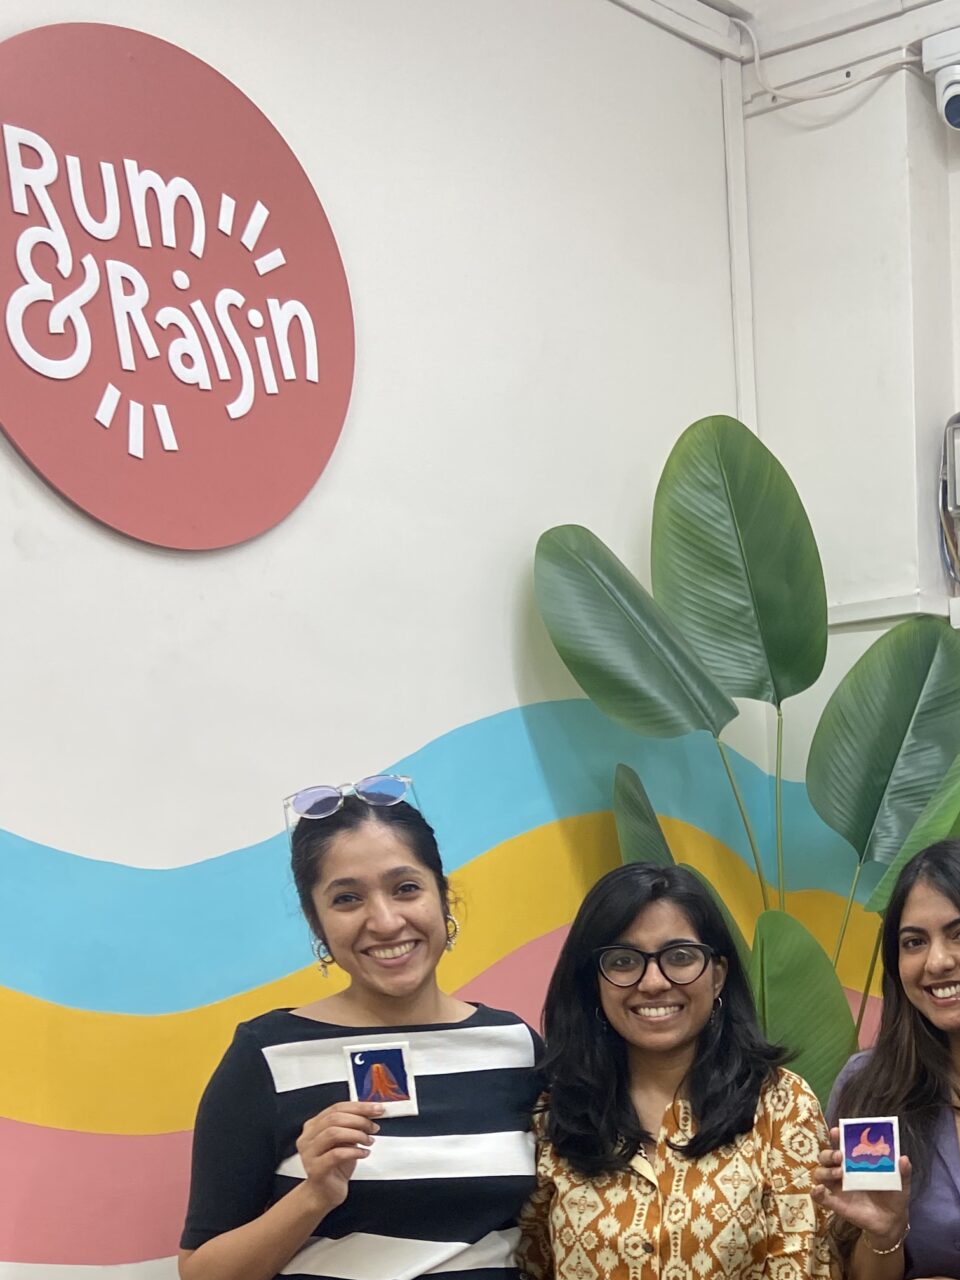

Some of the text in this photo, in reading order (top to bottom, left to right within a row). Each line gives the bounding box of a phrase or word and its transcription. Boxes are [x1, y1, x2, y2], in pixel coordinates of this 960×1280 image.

[2, 123, 206, 275] Rum
[6, 225, 319, 420] & Raisin
